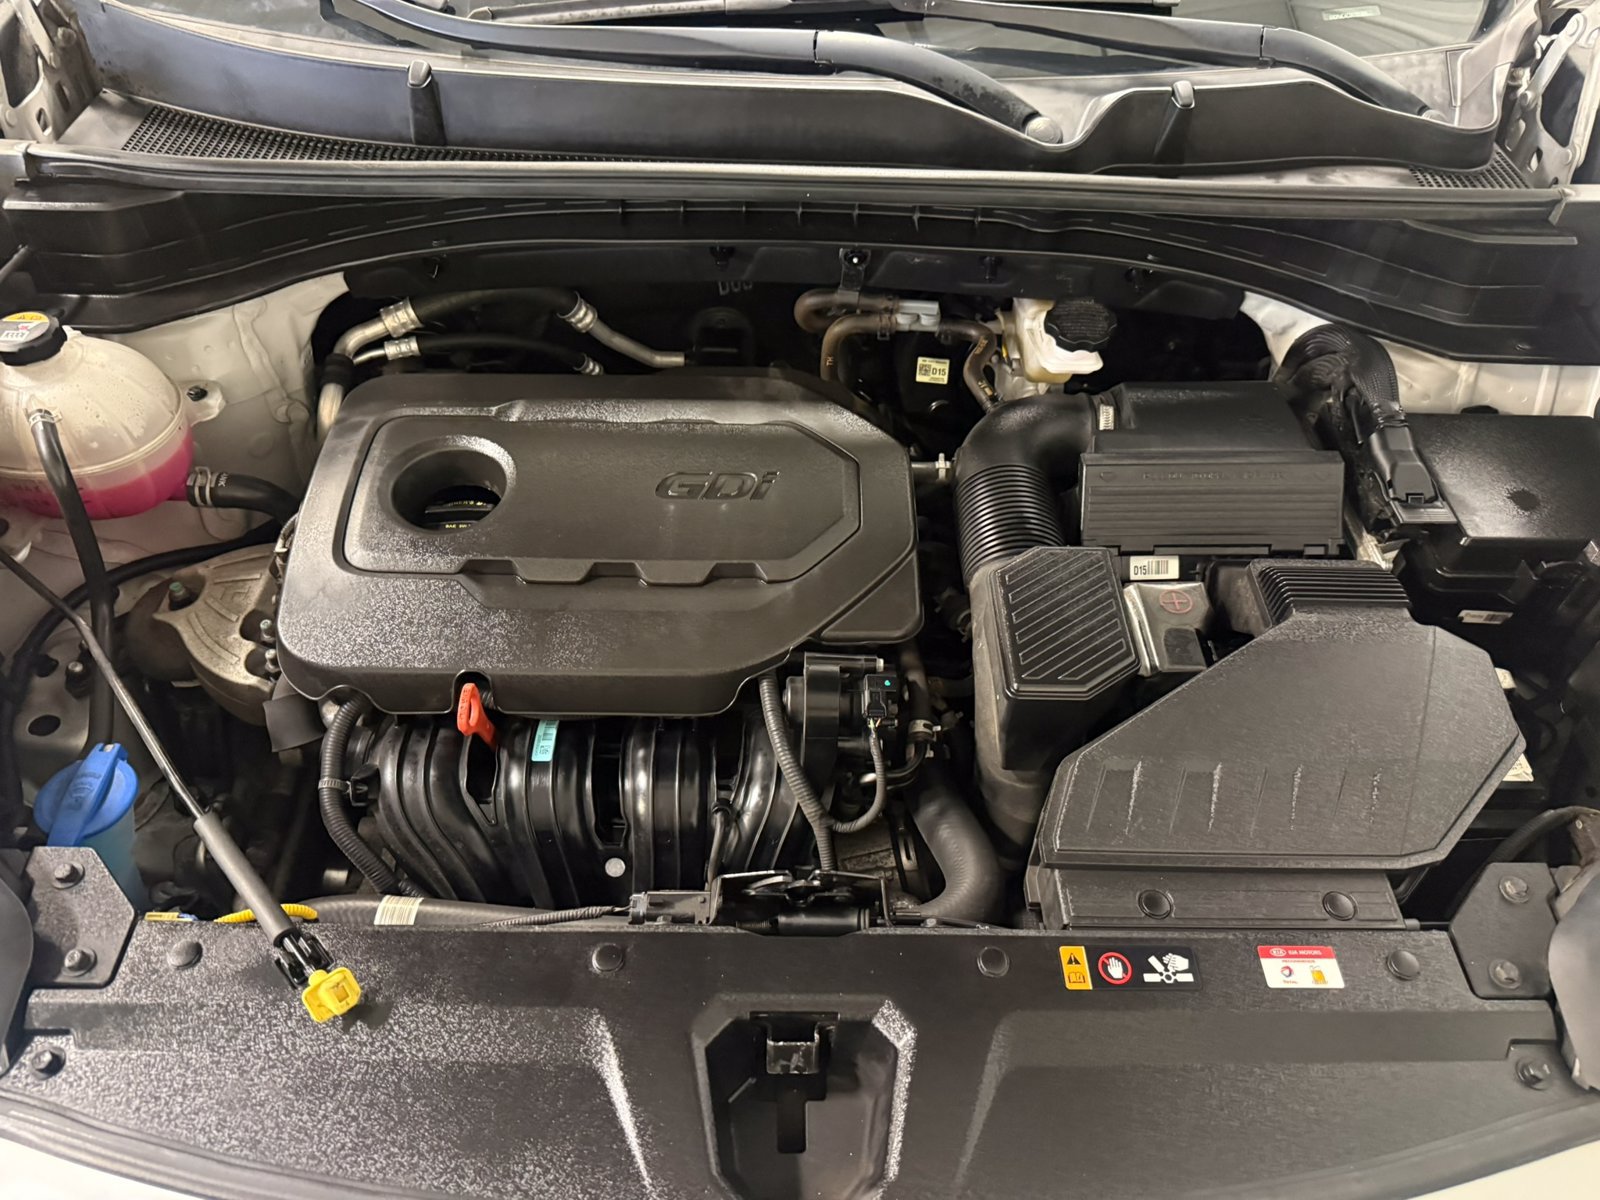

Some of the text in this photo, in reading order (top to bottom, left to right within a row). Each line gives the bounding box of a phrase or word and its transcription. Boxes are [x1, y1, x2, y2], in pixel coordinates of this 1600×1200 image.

[931, 367, 947, 377] D15
[655, 471, 780, 501] GDi
[1133, 565, 1147, 576] D15
